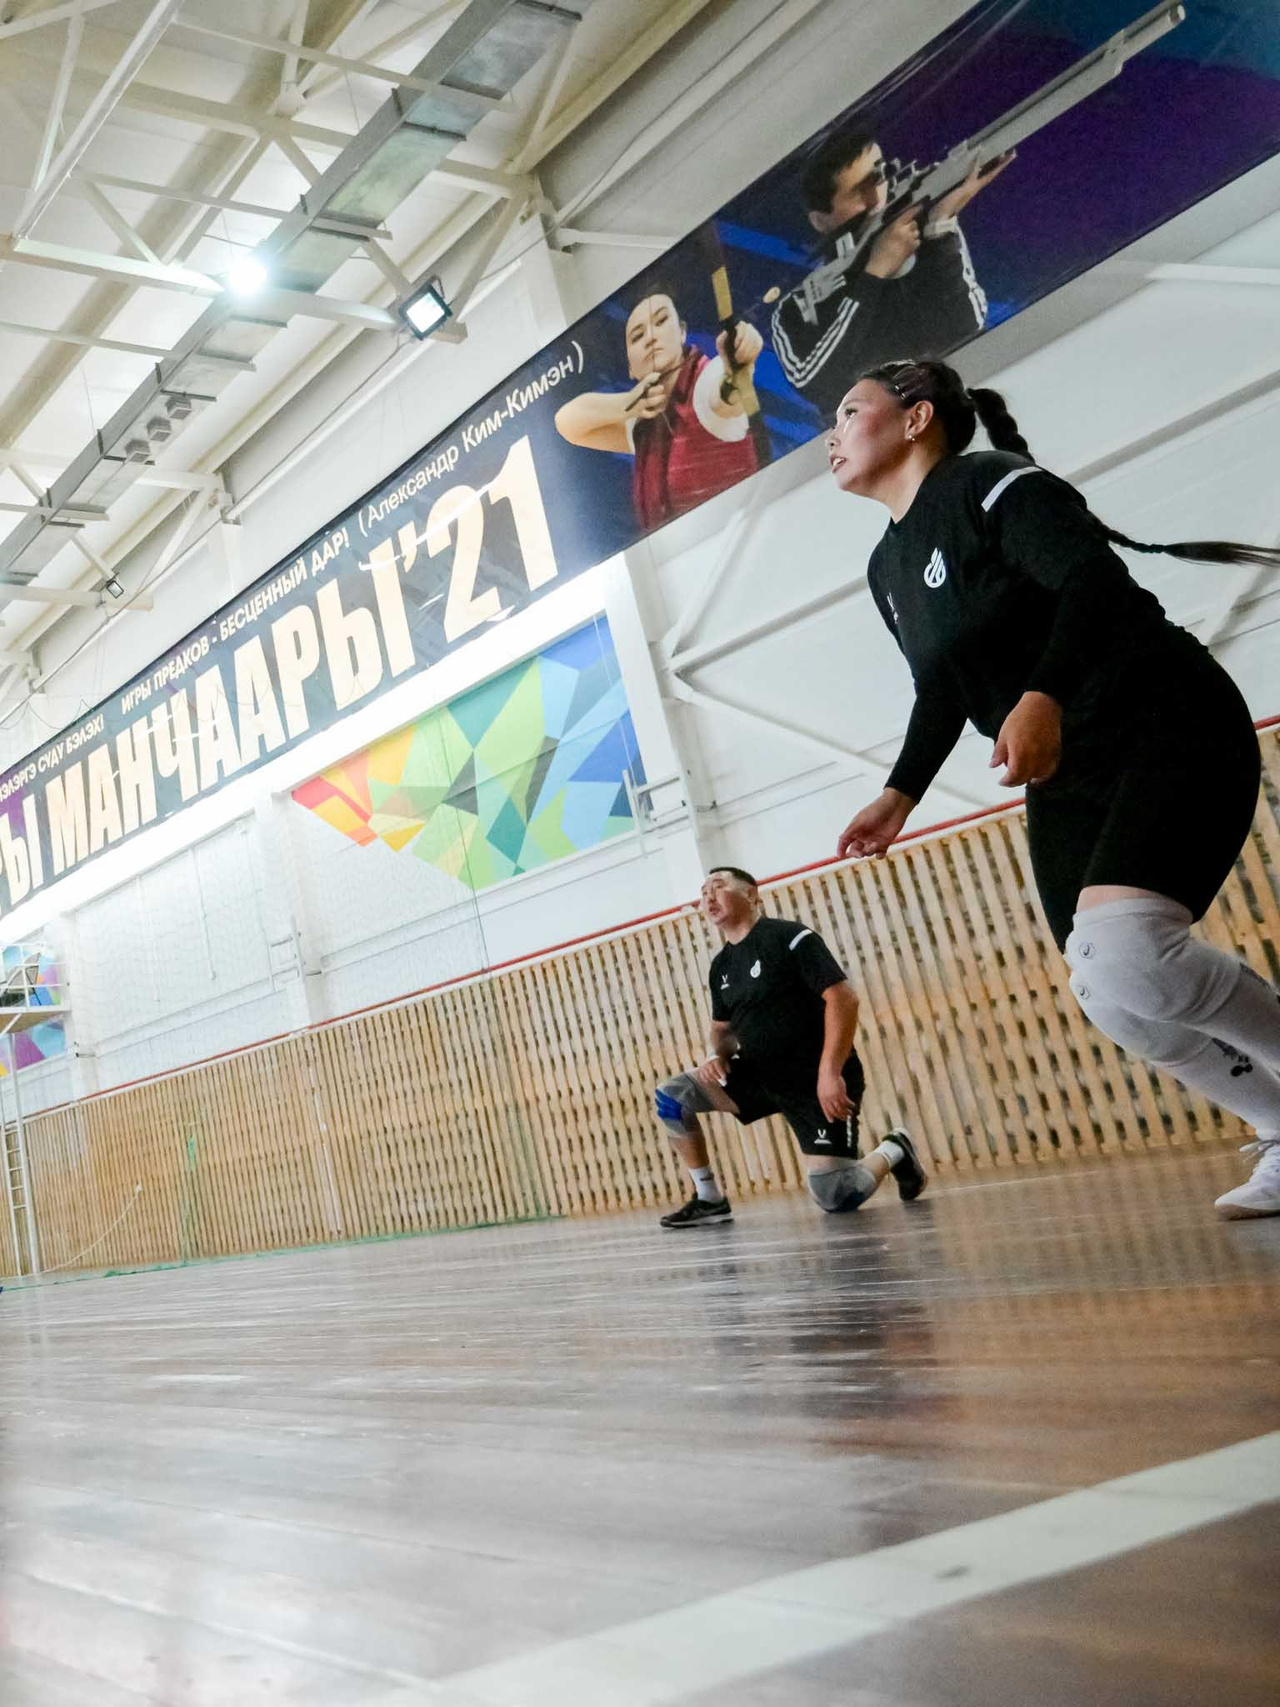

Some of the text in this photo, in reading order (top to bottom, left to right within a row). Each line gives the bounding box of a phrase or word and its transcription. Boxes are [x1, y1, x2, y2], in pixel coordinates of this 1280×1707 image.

[122, 679, 152, 715] ИГРЫ
[153, 636, 209, 691] ПРЕДКОВ
[220, 557, 308, 641] БЕСЦЕННЫЙ
[312, 527, 350, 577] ДАР!
[358, 445, 459, 538] (Александр
